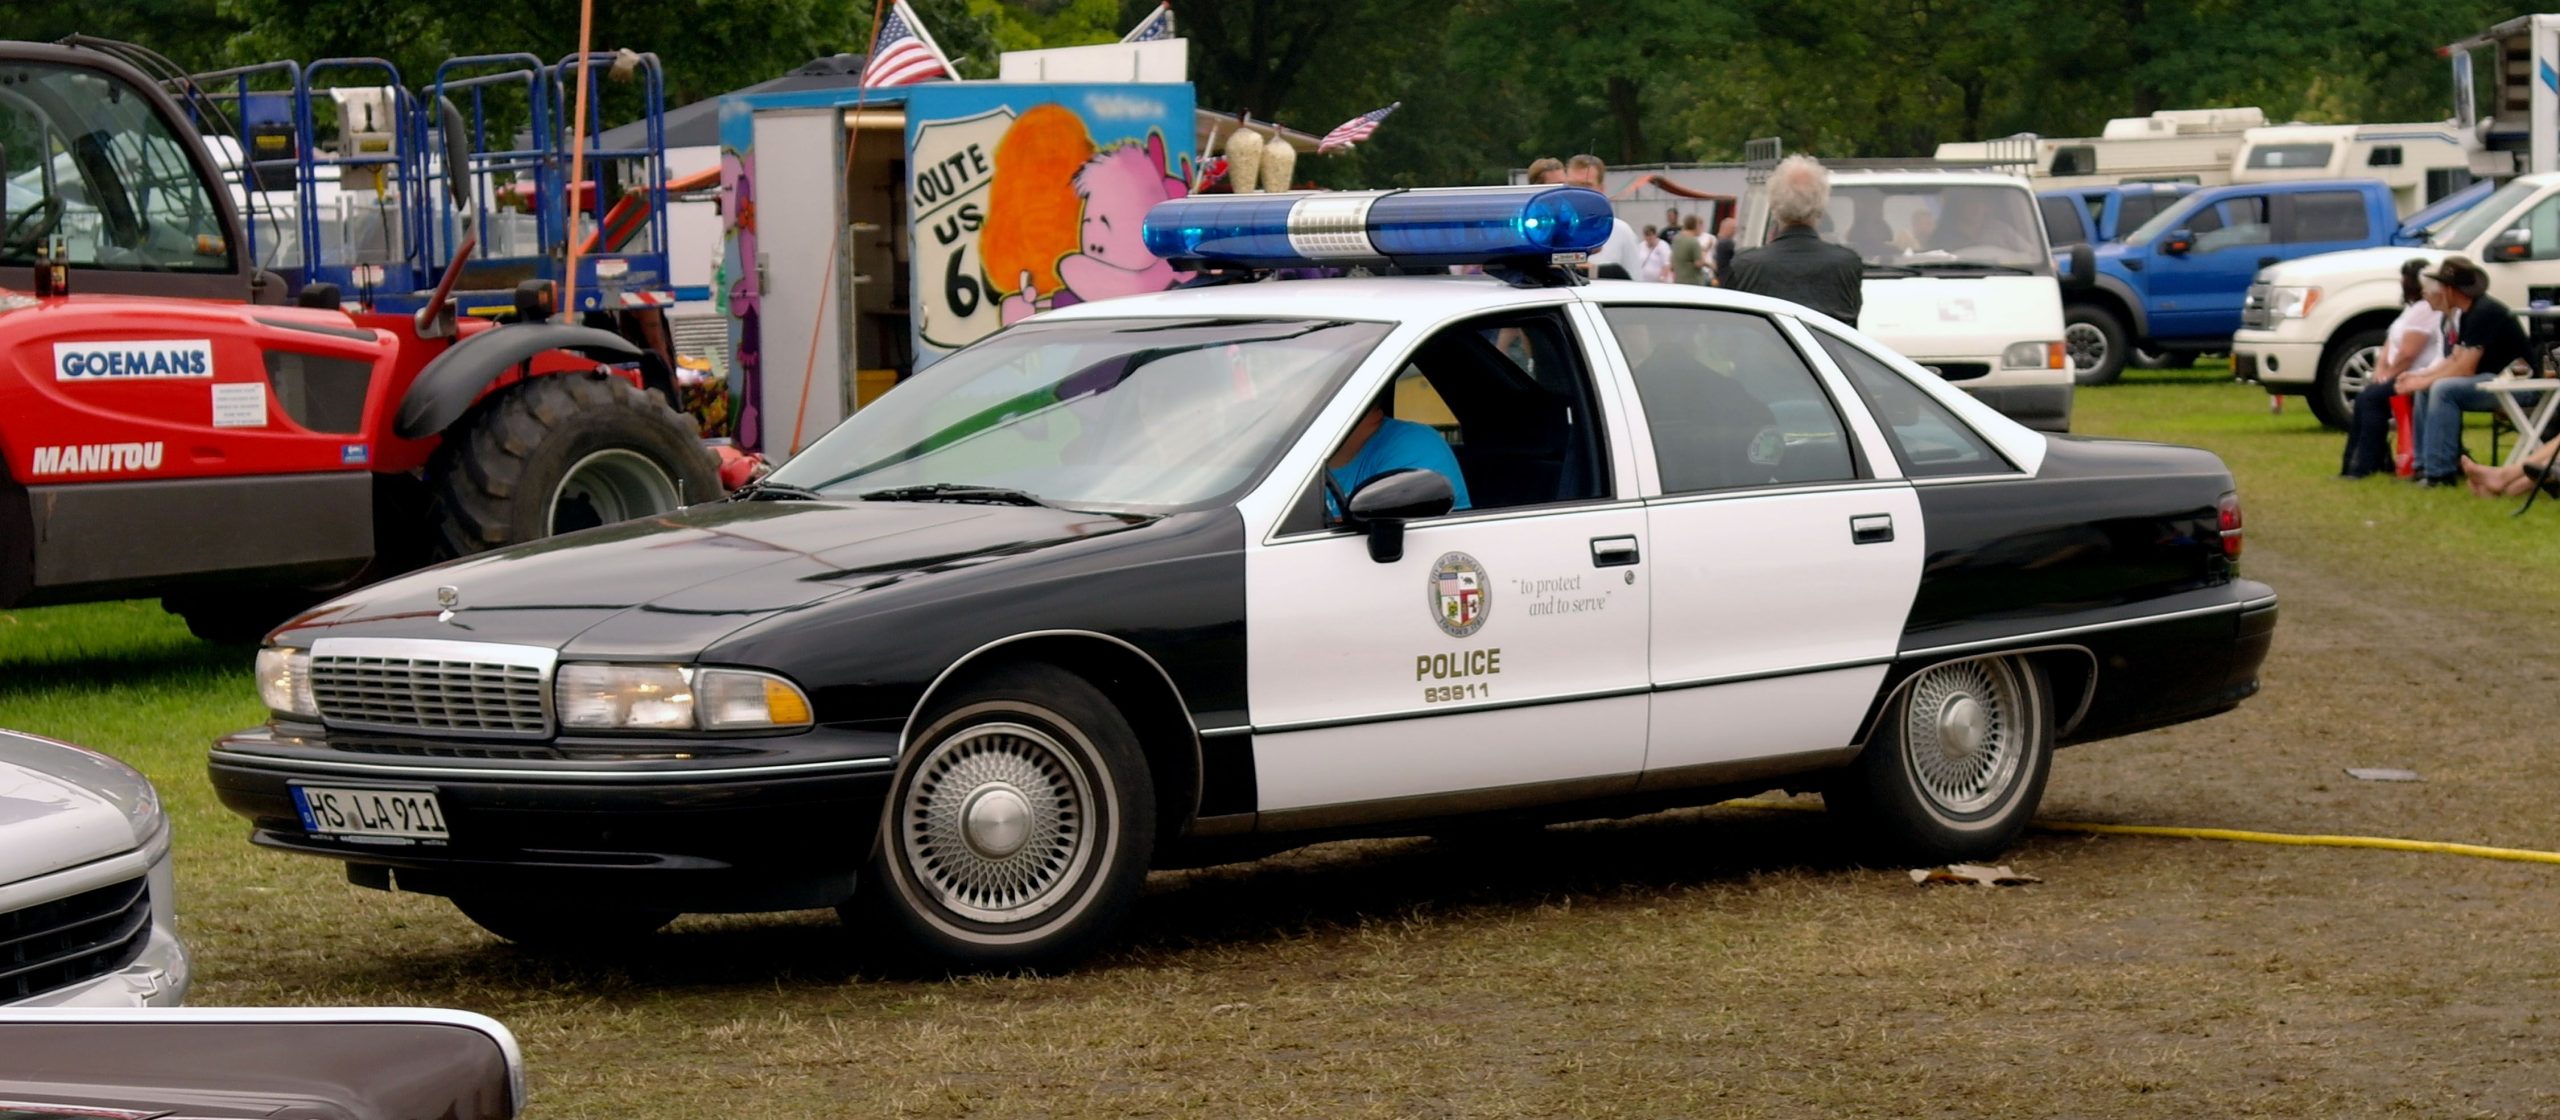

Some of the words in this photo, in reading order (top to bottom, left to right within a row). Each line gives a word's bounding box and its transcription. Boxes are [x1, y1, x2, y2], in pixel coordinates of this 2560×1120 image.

[933, 203, 984, 245] US
[62, 350, 206, 377] GOEMANS
[33, 441, 163, 475] MANITOU
[1536, 574, 1581, 598] protect
[1529, 596, 1554, 616] and
[1557, 599, 1570, 613] to
[1416, 648, 1501, 681] POLICE
[306, 793, 345, 828] HS
